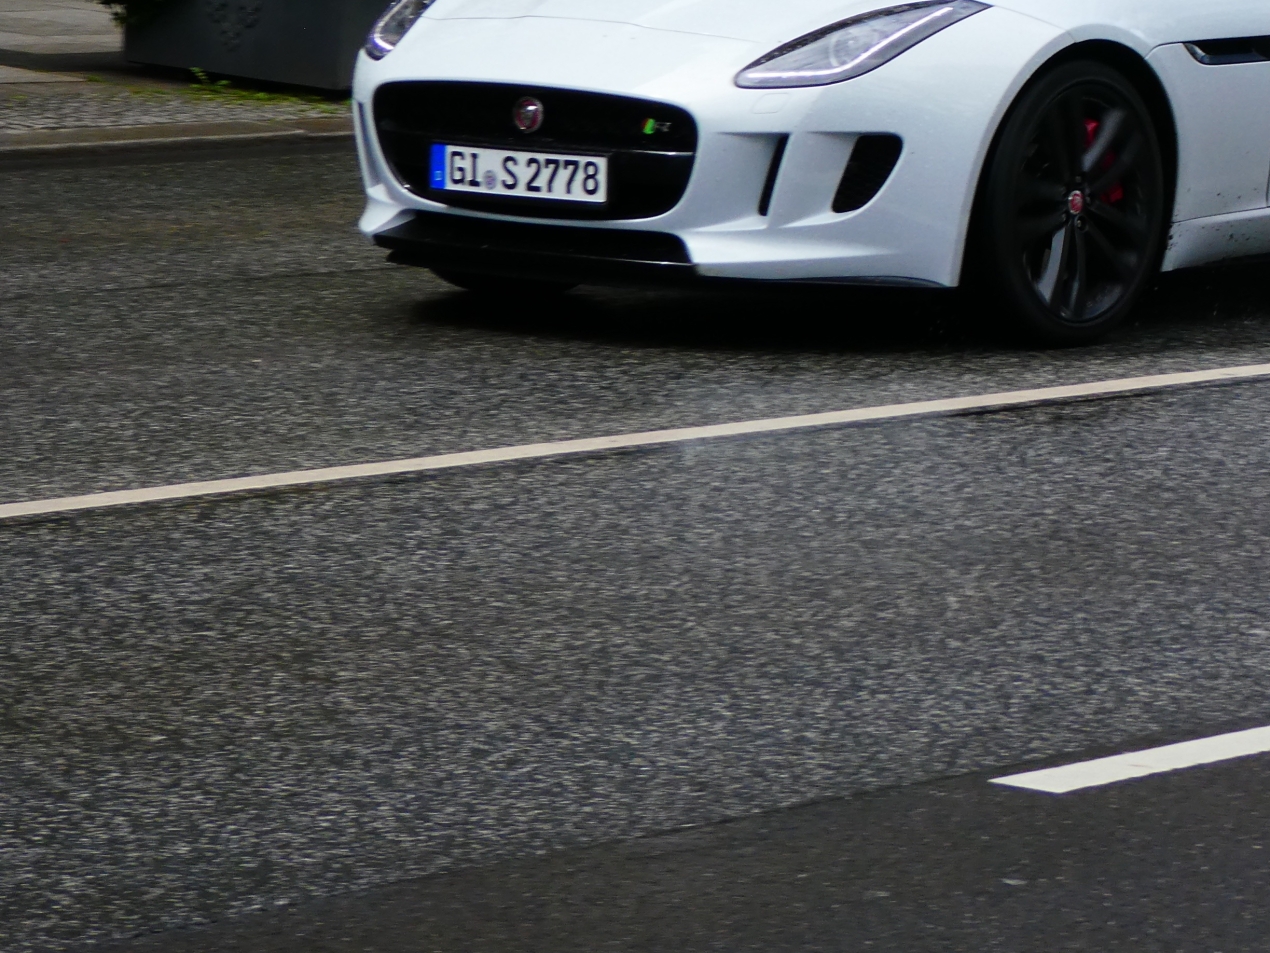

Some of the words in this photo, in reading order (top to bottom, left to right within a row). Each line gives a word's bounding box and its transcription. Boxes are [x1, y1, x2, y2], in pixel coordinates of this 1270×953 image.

[450, 151, 481, 187] GI
[502, 156, 519, 190] S
[525, 157, 600, 196] 2778
